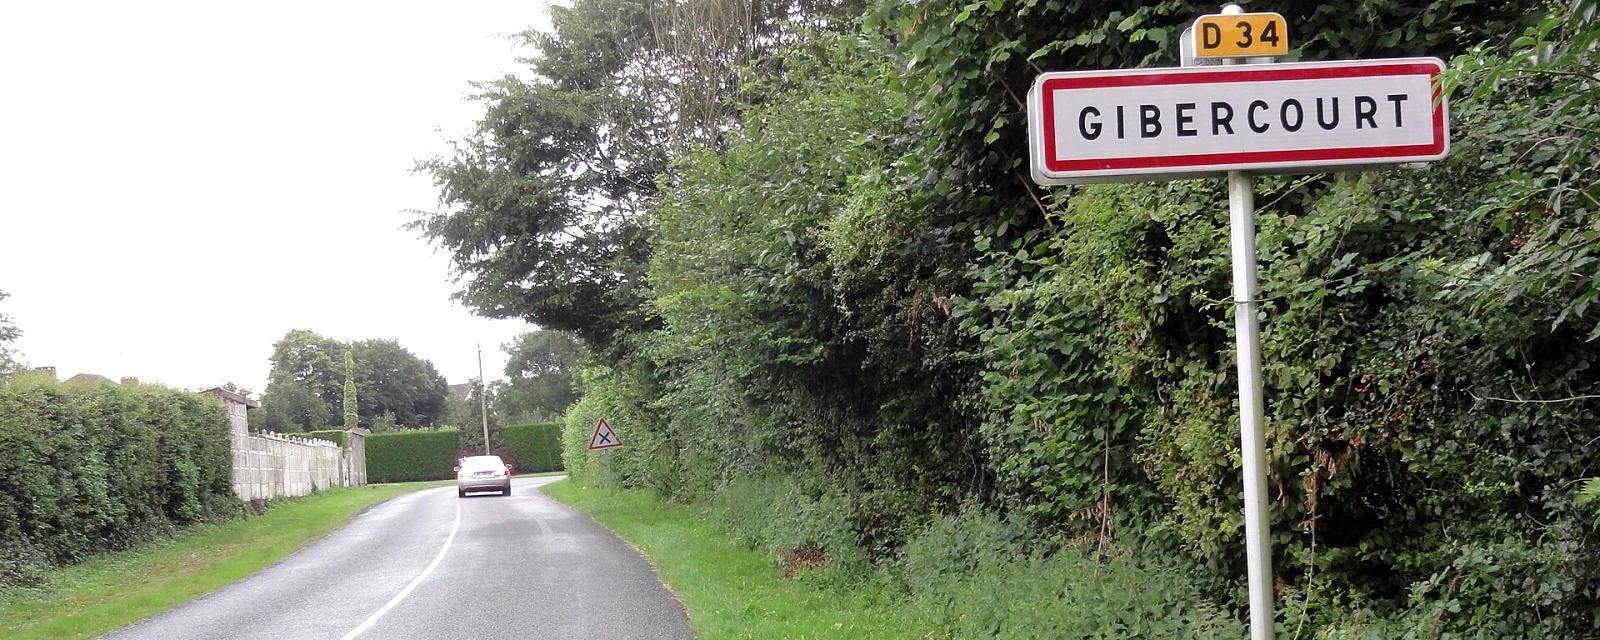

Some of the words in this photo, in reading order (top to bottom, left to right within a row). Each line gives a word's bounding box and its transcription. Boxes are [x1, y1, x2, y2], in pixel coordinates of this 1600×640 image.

[1202, 22, 1222, 50] D
[1236, 20, 1280, 49] 34
[1078, 94, 1408, 140] GIBERCOURT
